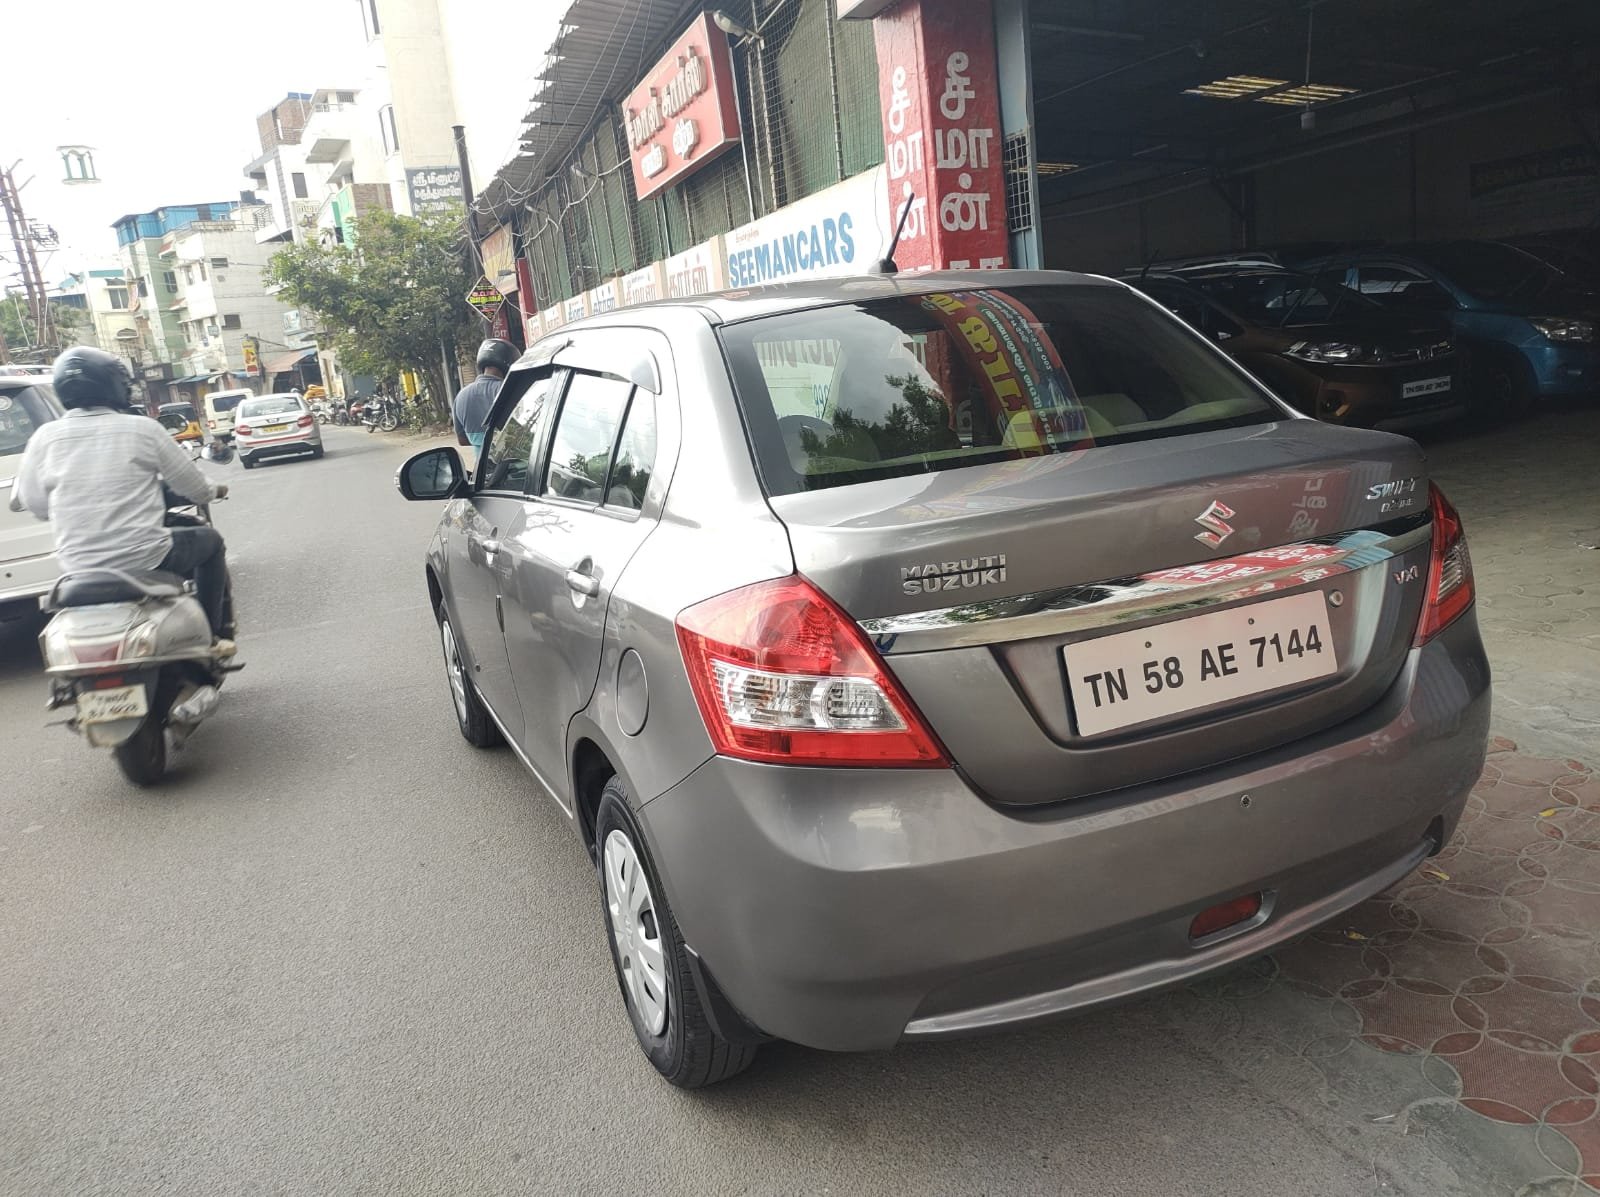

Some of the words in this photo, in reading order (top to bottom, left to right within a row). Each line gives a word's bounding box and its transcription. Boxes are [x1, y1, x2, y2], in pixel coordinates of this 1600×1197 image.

[935, 50, 993, 232] சீமான்
[729, 212, 855, 288] SEEMANCARS
[900, 553, 1006, 580] MARUTI
[903, 567, 1007, 596] SUZUKI
[1084, 668, 1129, 708] TN
[1143, 656, 1184, 694] 58
[1200, 643, 1238, 682] AE
[1249, 624, 1322, 668] 7144
